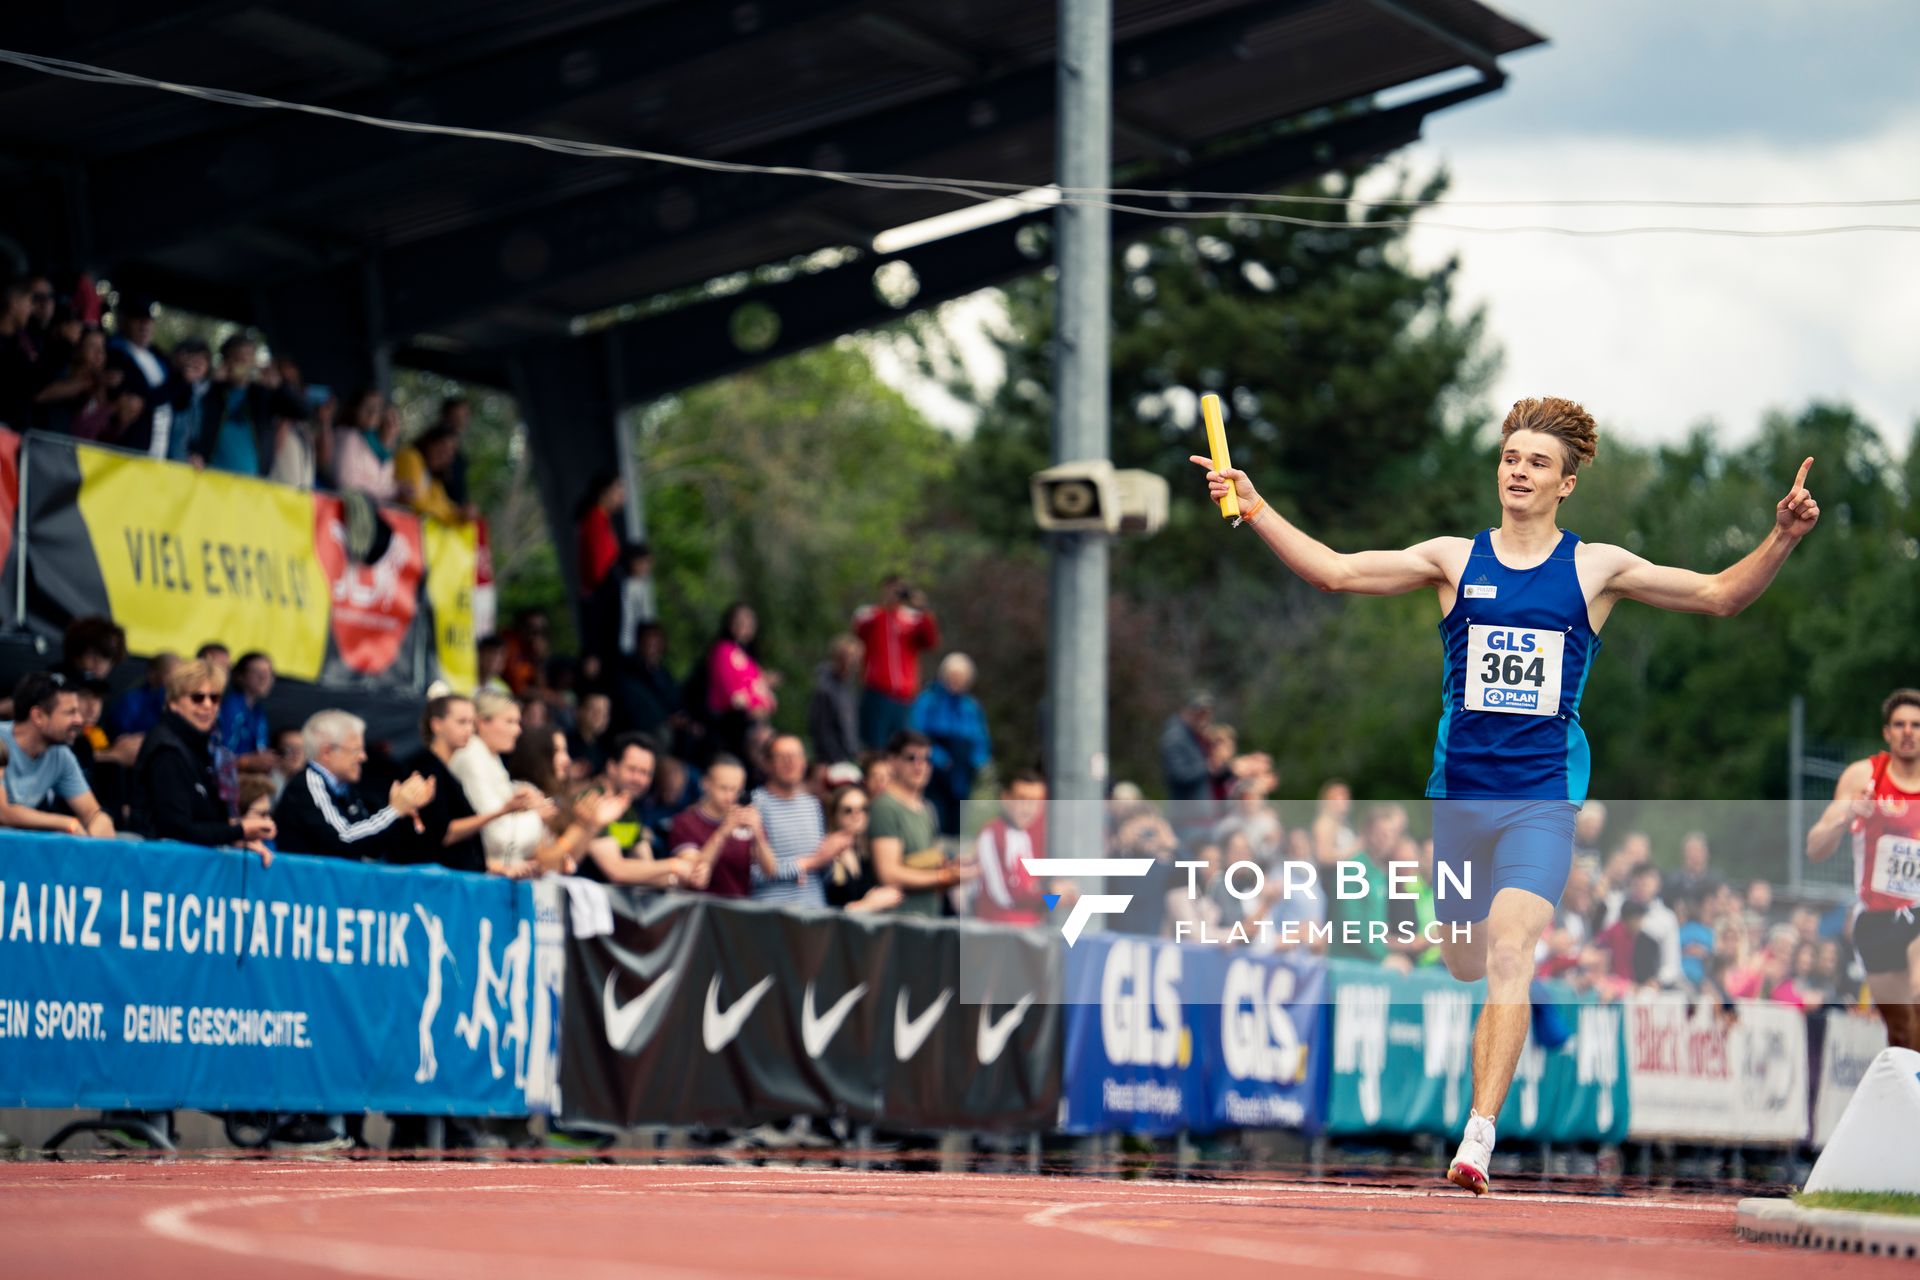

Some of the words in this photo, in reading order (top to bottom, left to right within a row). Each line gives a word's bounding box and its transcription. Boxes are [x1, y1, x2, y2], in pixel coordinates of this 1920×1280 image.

[125, 526, 191, 592] VIEL
[1481, 653, 1545, 687] 364
[1506, 692, 1536, 703] PLAN
[119, 888, 411, 968] LEICHTATHLETIK
[35, 1000, 106, 1041] SPORT.
[124, 1004, 184, 1043] DEINE
[187, 1007, 312, 1048] GESCHICHTE.
